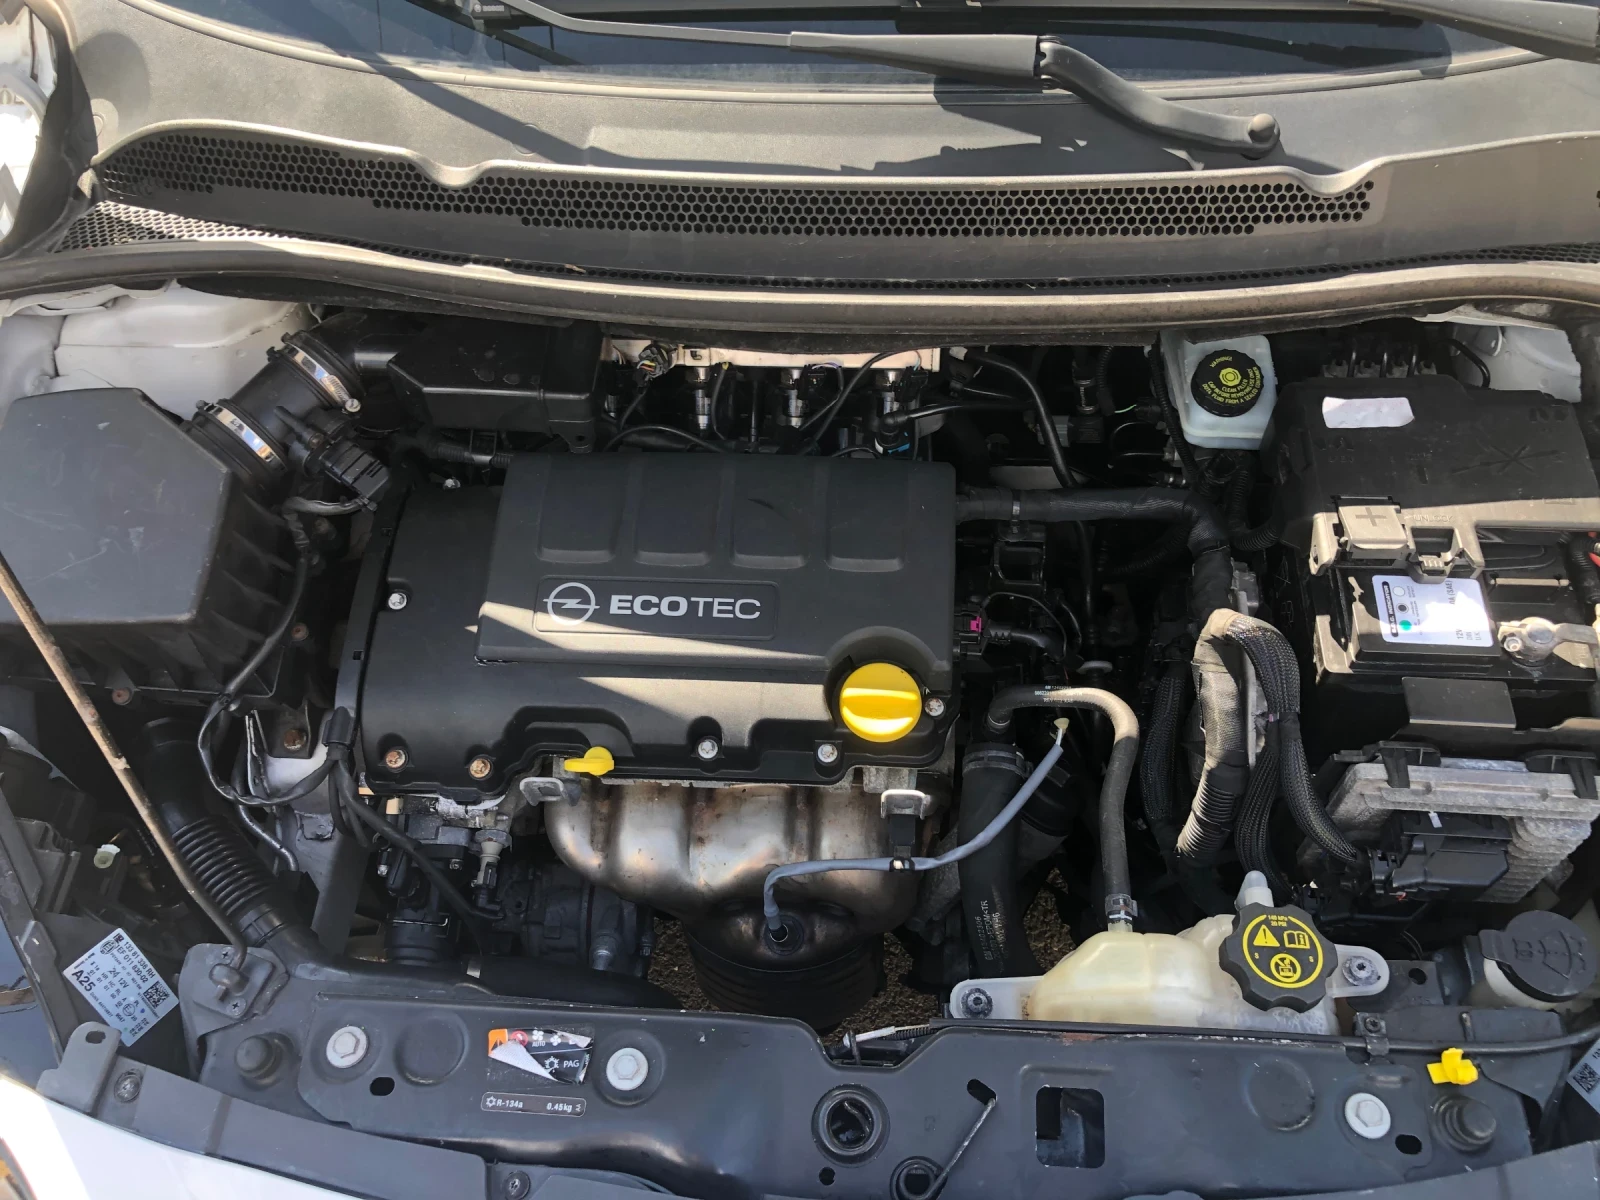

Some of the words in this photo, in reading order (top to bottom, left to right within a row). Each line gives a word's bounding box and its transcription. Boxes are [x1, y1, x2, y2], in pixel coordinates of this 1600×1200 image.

[609, 594, 761, 619] ECOTEC
[114, 943, 126, 956] 1EF
[122, 953, 134, 965] 011
[122, 940, 134, 952] 133
[130, 950, 140, 959] 81
[136, 957, 149, 970] 336
[144, 967, 155, 979] RH
[71, 966, 96, 993] A25
[116, 977, 129, 989] 12V
[532, 1040, 546, 1048] AUTO
[563, 1059, 580, 1068] PAG
[496, 1098, 523, 1109] R-134a
[546, 1102, 573, 1113] 0.45kg
